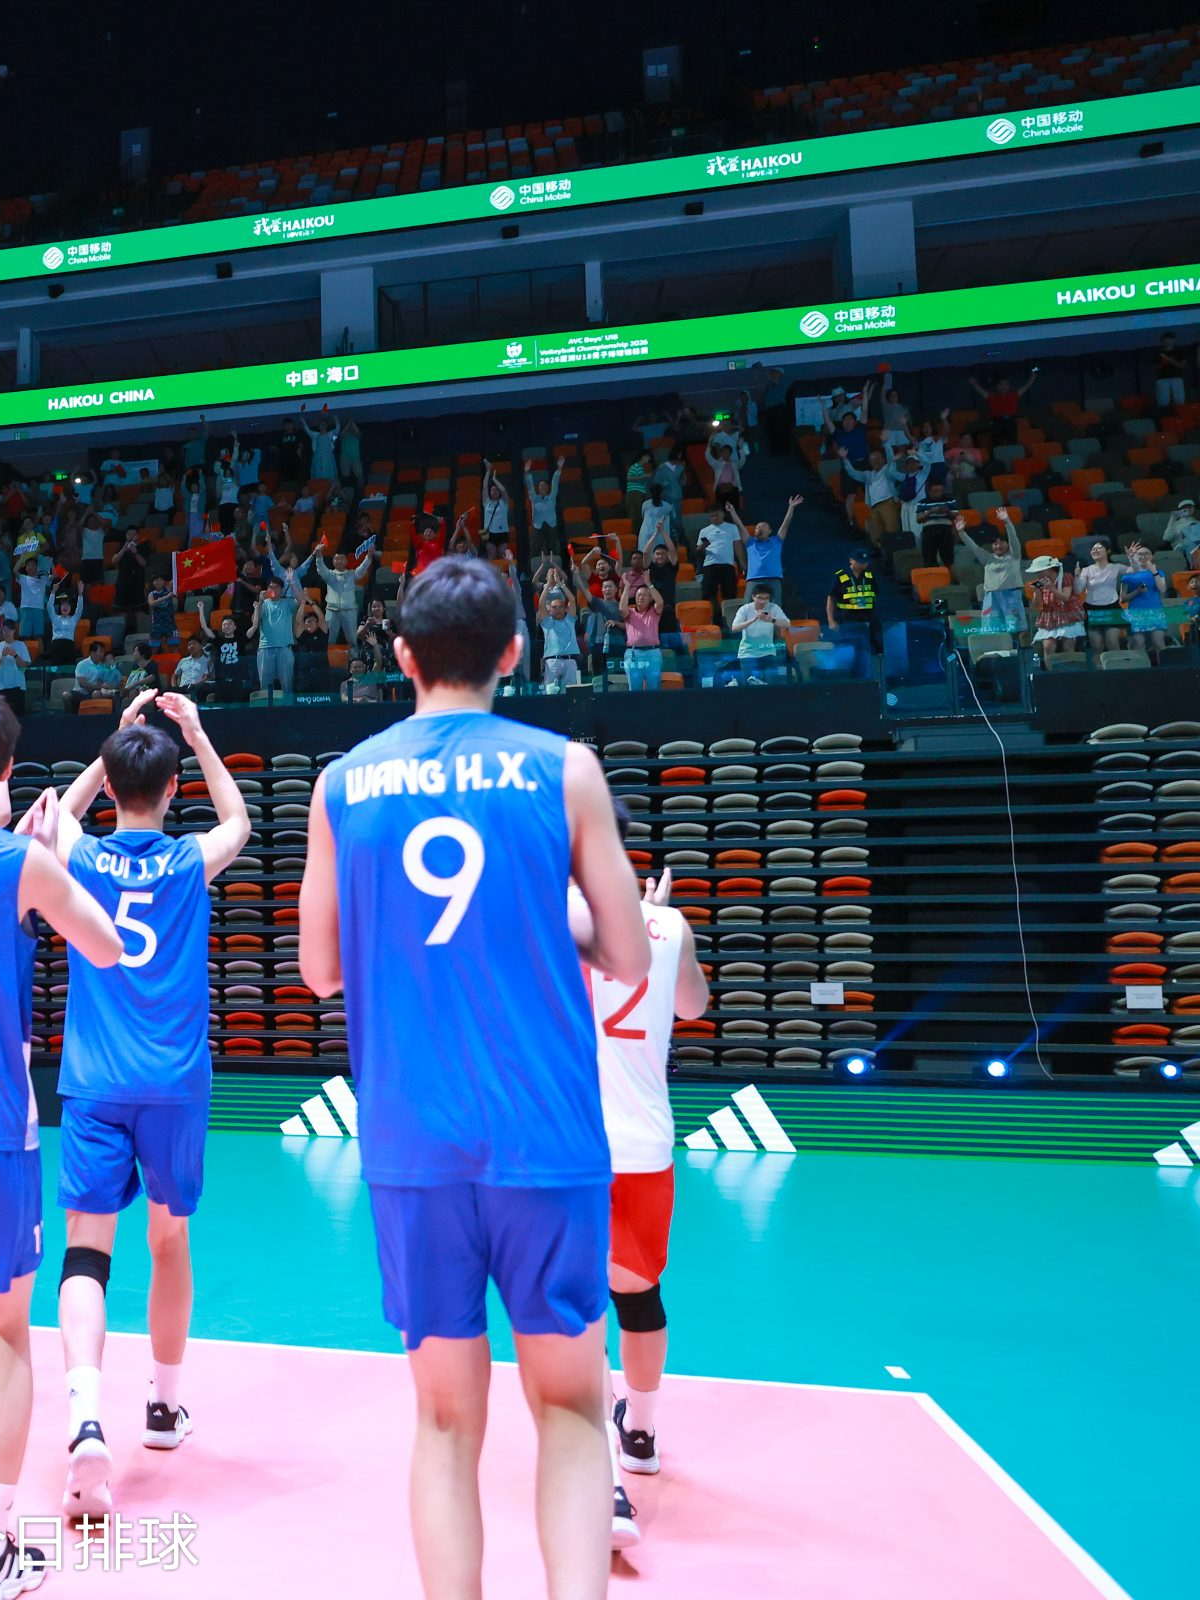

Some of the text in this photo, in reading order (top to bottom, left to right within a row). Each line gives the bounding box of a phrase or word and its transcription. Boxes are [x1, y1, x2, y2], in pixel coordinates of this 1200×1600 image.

[1021, 109, 1083, 129] 中国移动
[1022, 123, 1083, 138] China Mobile
[519, 178, 572, 195] 中国移动
[519, 191, 571, 205] China Mobile
[67, 241, 112, 257] 中国移动
[67, 253, 112, 265] China Mobile
[1056, 284, 1135, 305] HAIKOU
[834, 304, 896, 323] 中国移动
[835, 318, 896, 334] China Mobile
[540, 339, 648, 357] Volleyball Championship 2026
[568, 337, 583, 345] AVC
[48, 388, 155, 411] HAIKOU CHINA
[346, 751, 538, 806] WANG H.X.
[95, 852, 174, 881] CUI J.Y.
[402, 815, 486, 946] 9
[114, 890, 158, 968] 5
[33, 1220, 44, 1254] 1
